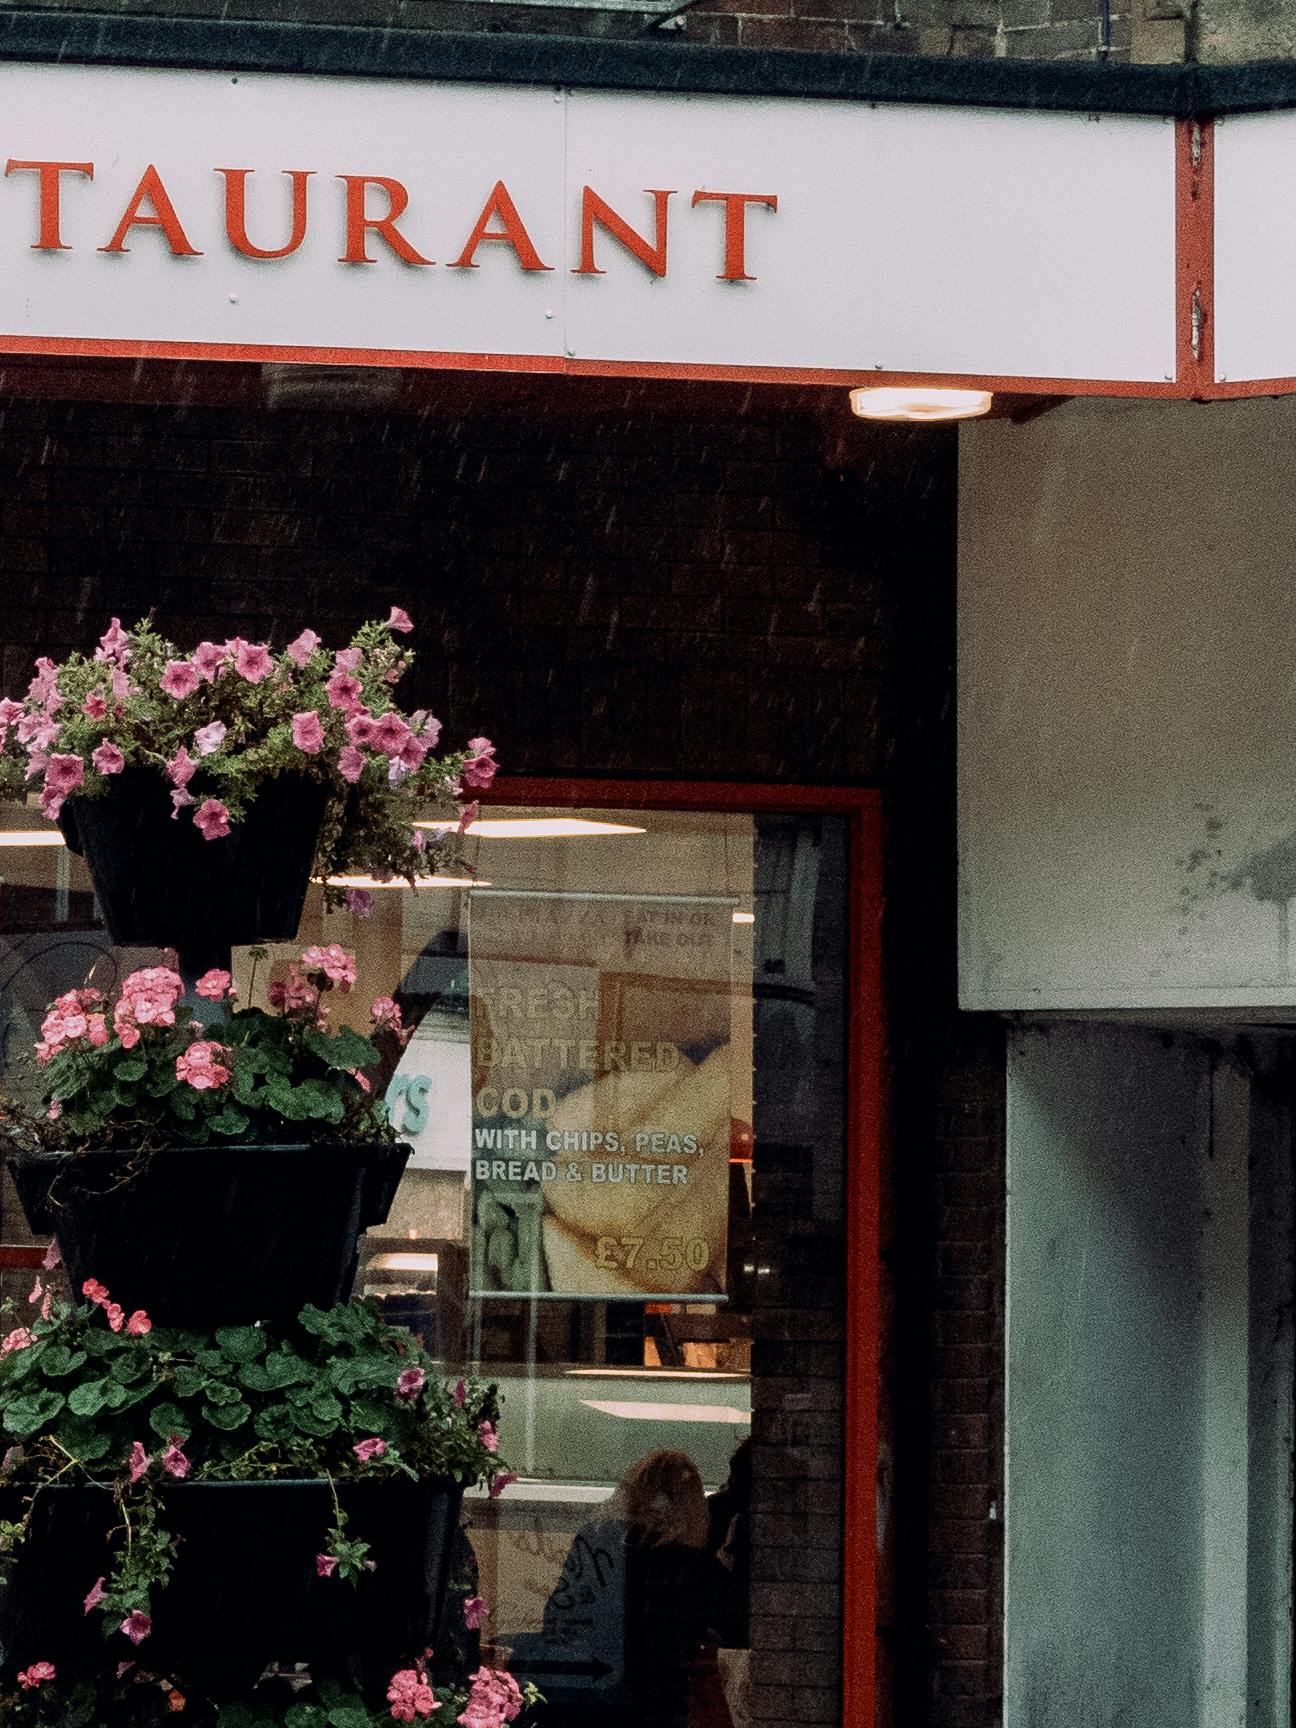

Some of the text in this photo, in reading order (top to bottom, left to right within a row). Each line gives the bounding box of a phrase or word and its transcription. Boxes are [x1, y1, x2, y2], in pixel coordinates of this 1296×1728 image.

[477, 985, 600, 1020] FRESH
[477, 1037, 681, 1074] BATTERED
[475, 1085, 557, 1119] COD
[475, 1127, 705, 1158] WITH CHIPS, PEAS,
[475, 1159, 689, 1185] BREAD & BUTTER
[596, 1235, 711, 1272] £7.50
